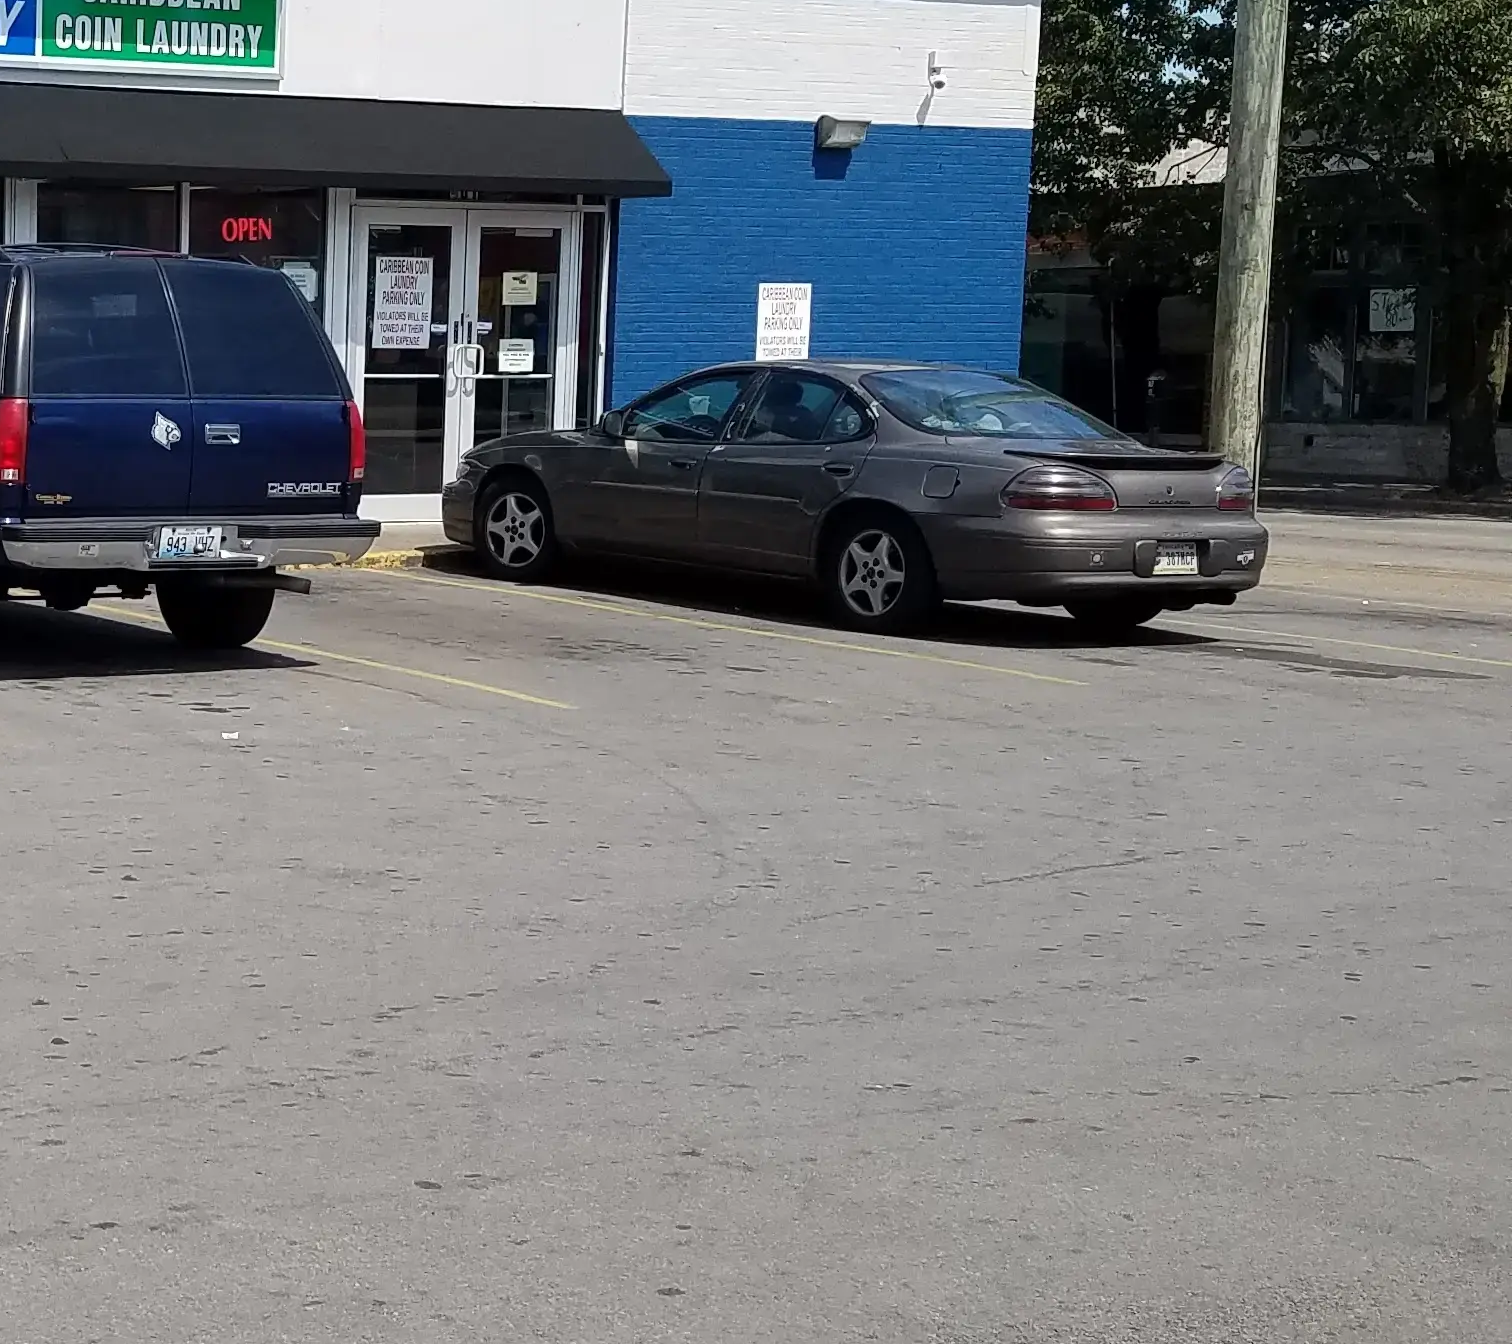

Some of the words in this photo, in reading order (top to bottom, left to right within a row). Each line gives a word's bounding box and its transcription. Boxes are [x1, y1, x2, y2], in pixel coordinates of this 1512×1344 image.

[55, 13, 123, 52] COIN
[136, 18, 263, 59] LAUNDRY
[222, 217, 272, 242] OPEN
[380, 259, 413, 274] CARIBBEAN
[415, 260, 429, 274] COIN
[390, 276, 418, 290] LAUNDRY
[382, 291, 408, 305] PARKING
[409, 292, 425, 306] ONLY
[762, 287, 793, 300] CARIBBEAN
[794, 287, 808, 300] COIN
[772, 302, 797, 315] LAUNDRY
[377, 311, 406, 320] VIOLATORS
[407, 312, 420, 321] WILL
[421, 312, 429, 321] BE
[380, 324, 399, 333] TOWED
[400, 324, 407, 333] AT
[408, 324, 424, 333] THEIR
[764, 317, 787, 330] PARKING
[789, 317, 803, 330] ONLY
[381, 336, 394, 345] OWN
[396, 336, 420, 345] EXPENSE
[268, 482, 341, 494] CHEVROLET
[167, 537, 187, 552] 943
